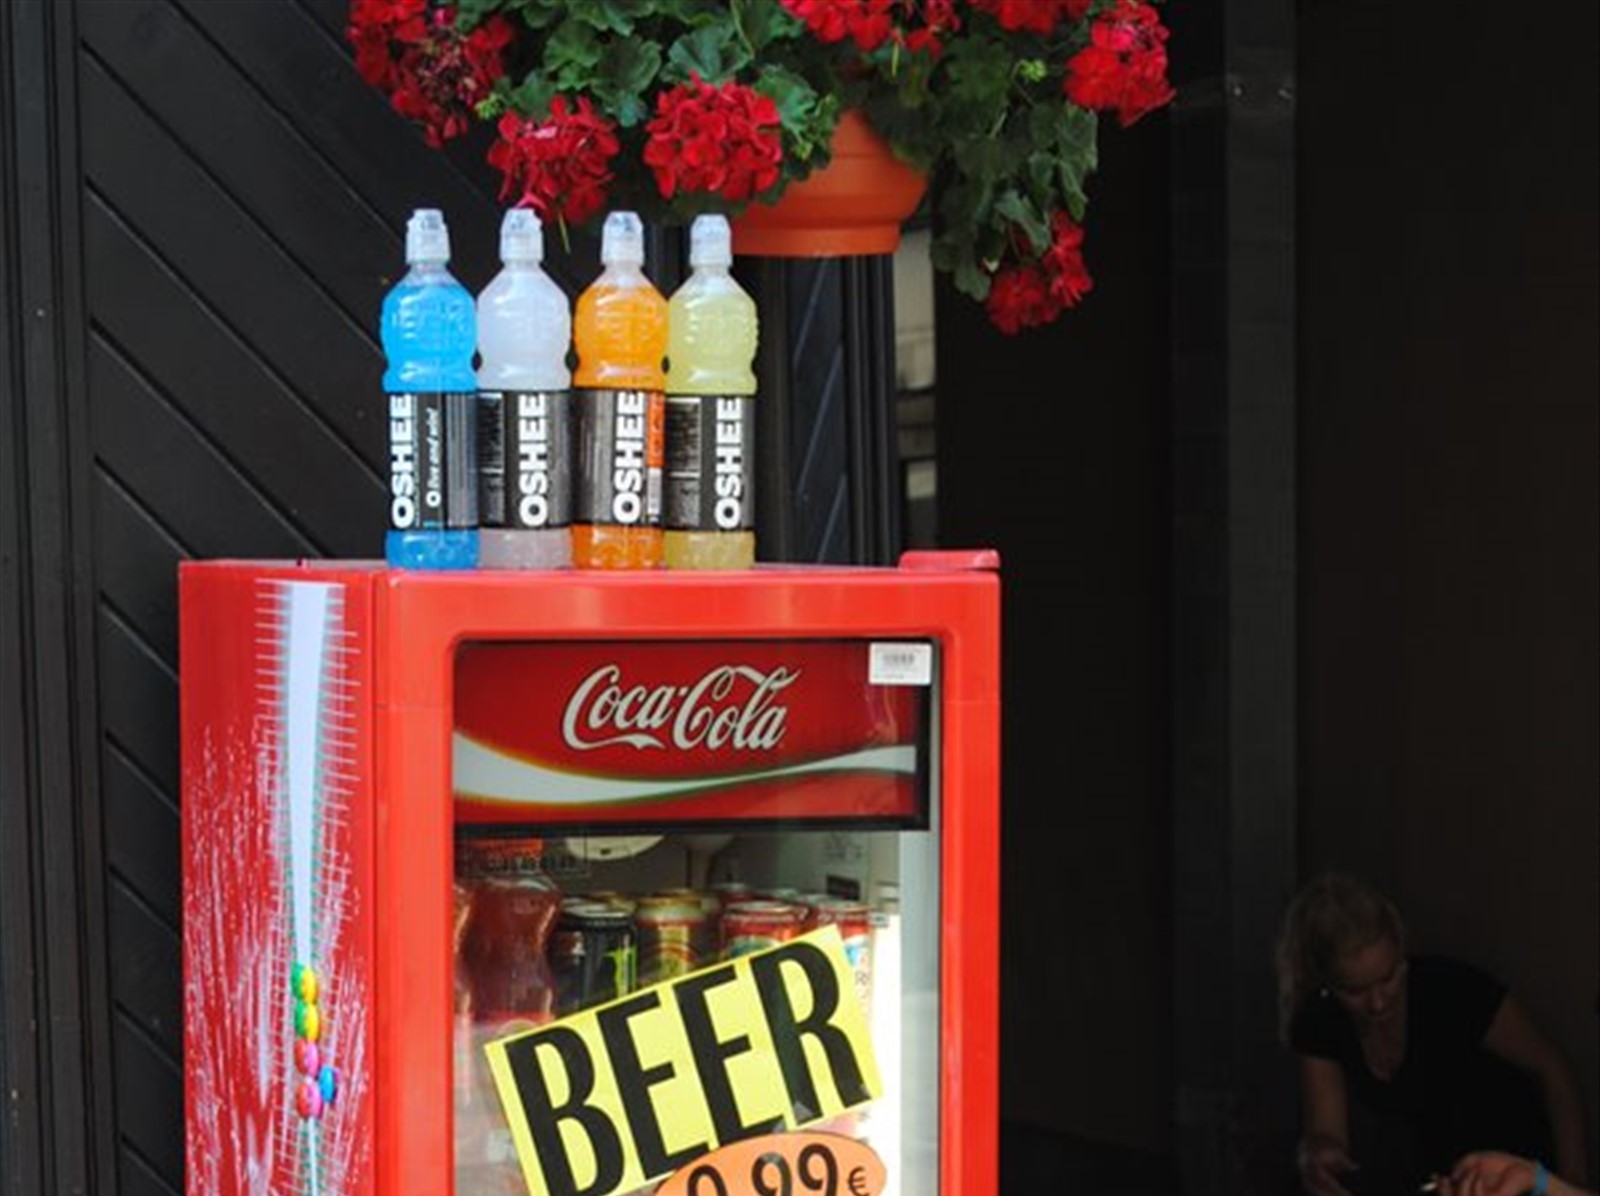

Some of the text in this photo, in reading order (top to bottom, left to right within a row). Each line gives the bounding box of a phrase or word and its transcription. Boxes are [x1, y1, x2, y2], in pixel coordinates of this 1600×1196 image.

[390, 394, 415, 528] OSHEE
[519, 394, 548, 527] OSHEE
[613, 391, 645, 524] OSHEE
[714, 396, 742, 529] OSHEE
